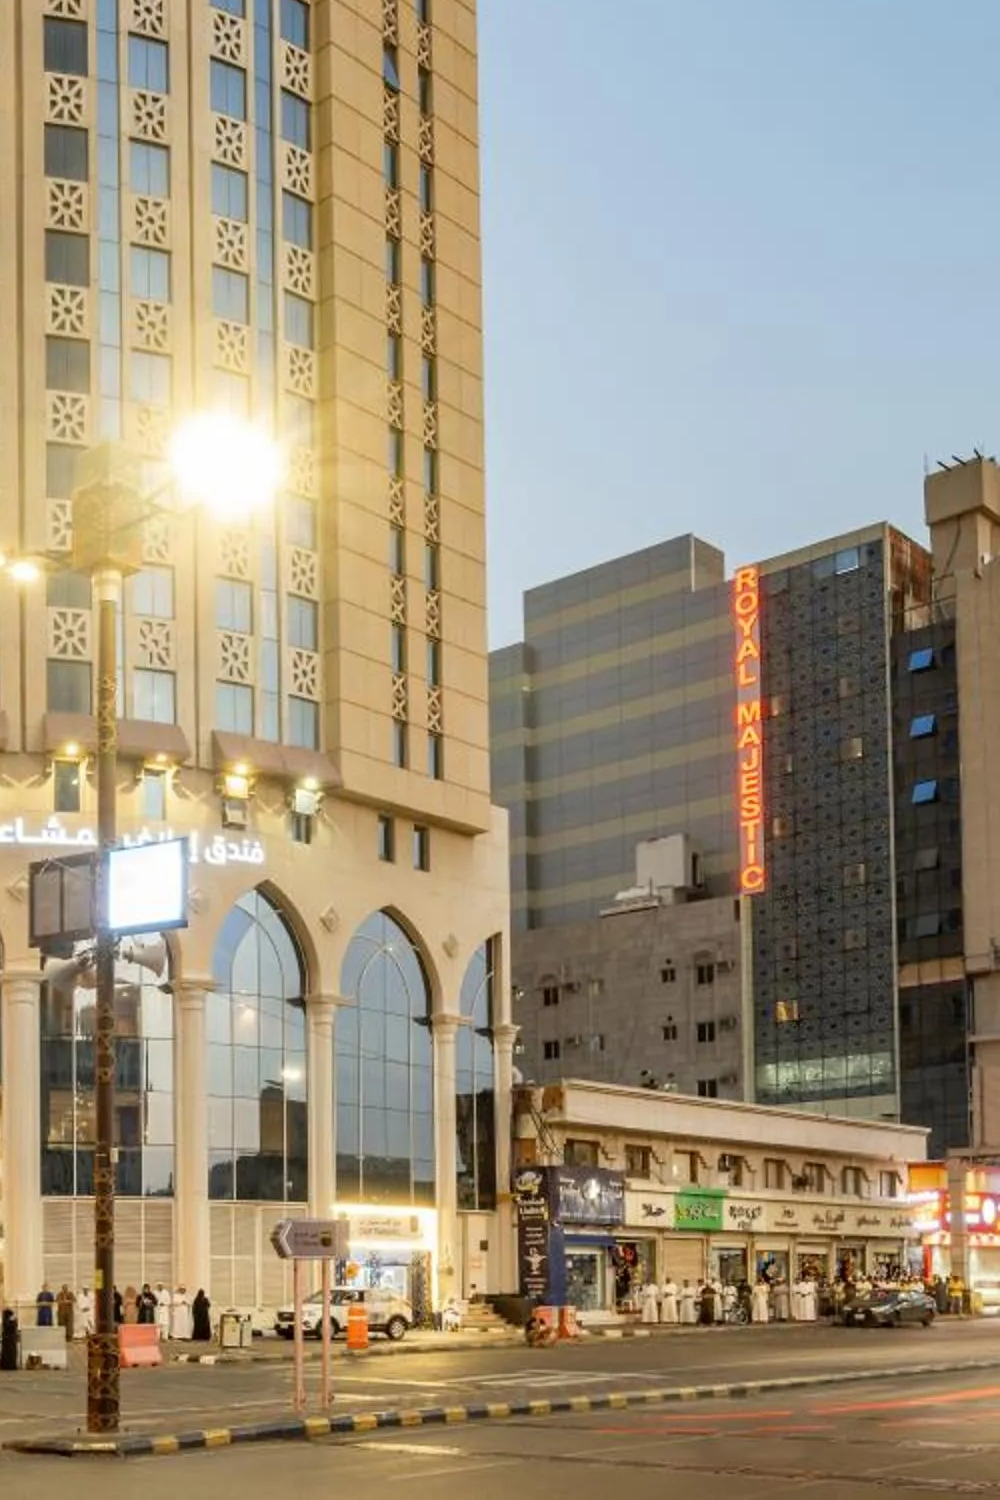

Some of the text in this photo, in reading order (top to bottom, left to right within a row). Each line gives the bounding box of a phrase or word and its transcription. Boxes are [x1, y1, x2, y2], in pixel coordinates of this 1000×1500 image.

[735, 565, 765, 890] ROYAL MAJESTIC
[203, 831, 265, 866] فندق
